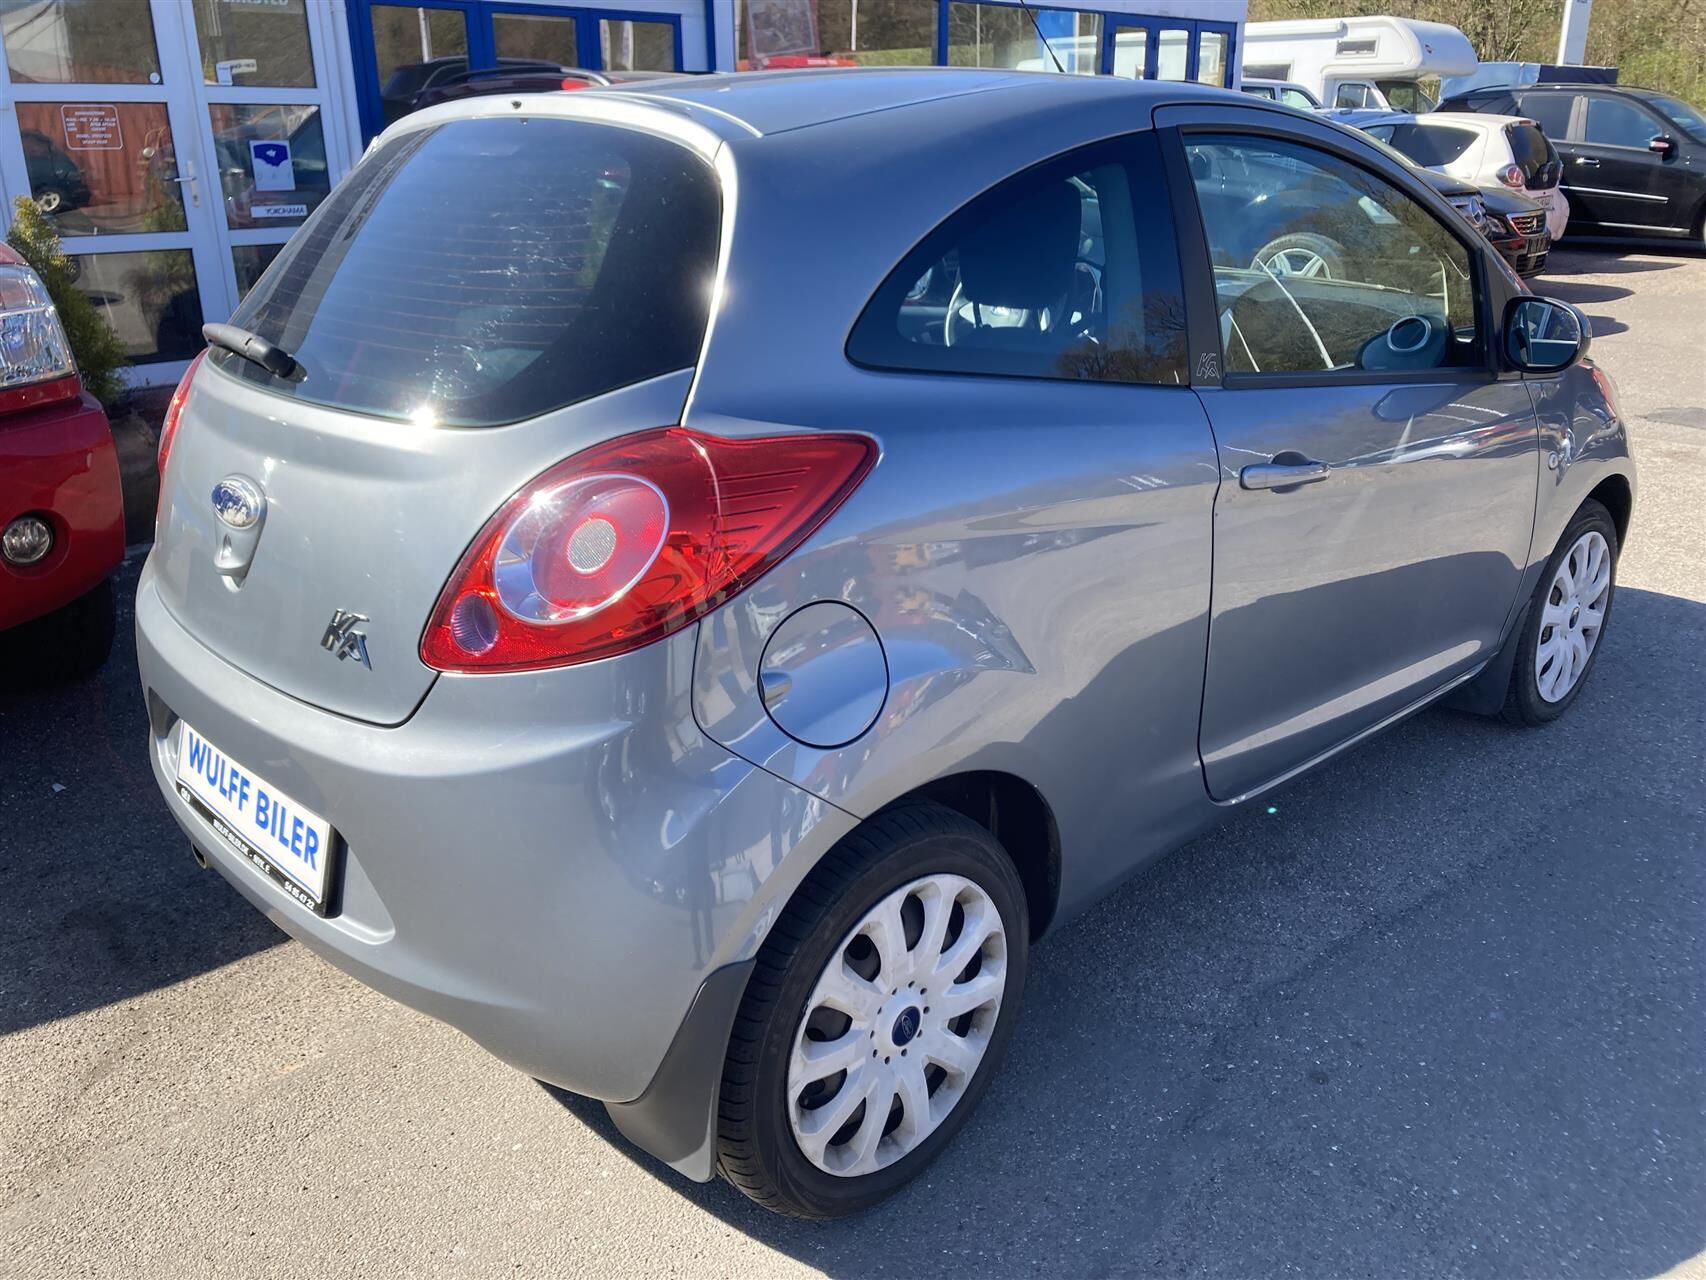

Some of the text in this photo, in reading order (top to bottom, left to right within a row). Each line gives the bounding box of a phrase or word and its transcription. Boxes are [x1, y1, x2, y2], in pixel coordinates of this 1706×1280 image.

[266, 207, 305, 216] YOKOHAMA
[320, 608, 372, 671] KA
[188, 731, 319, 872] WULFF BILER
